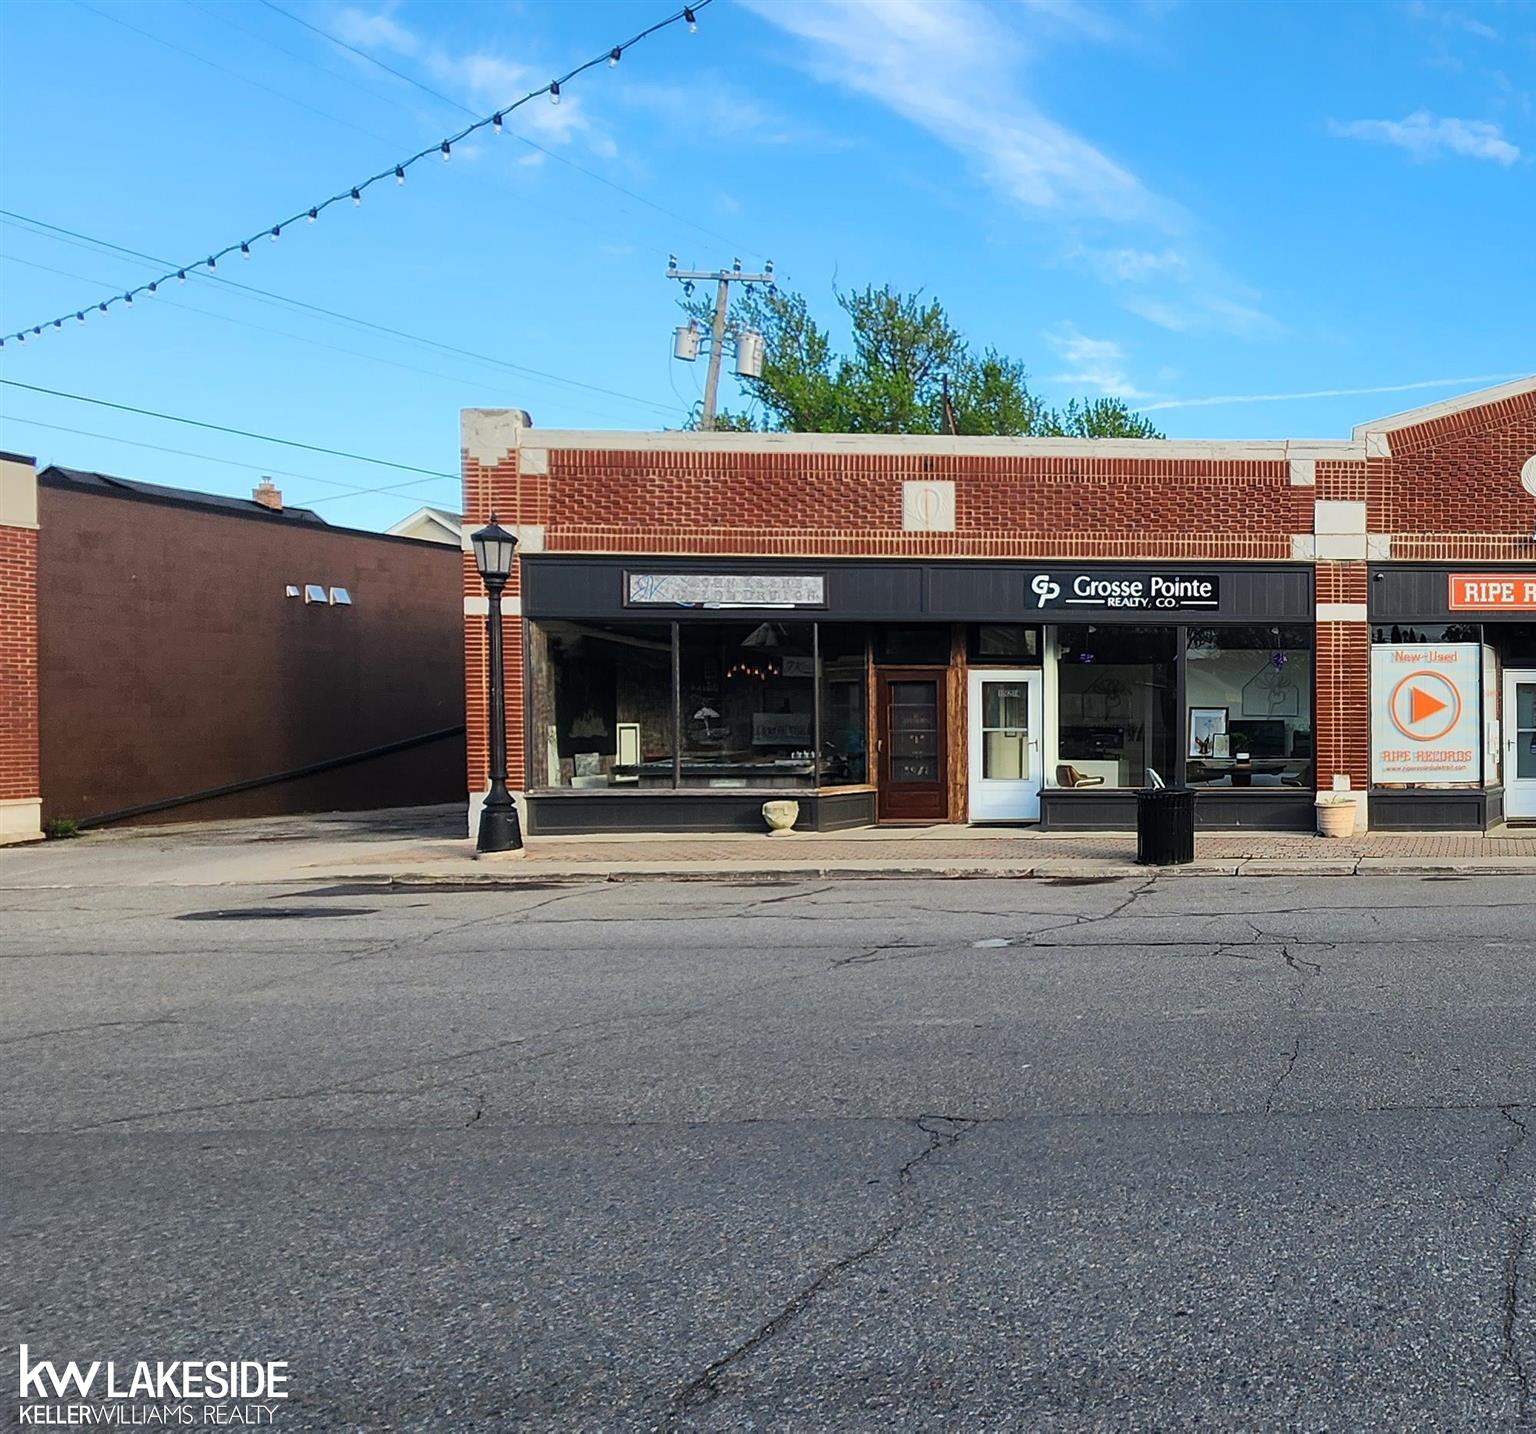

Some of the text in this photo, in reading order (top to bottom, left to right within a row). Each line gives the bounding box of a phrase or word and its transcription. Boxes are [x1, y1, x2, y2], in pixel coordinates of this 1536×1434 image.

[1073, 575, 1212, 597] Grosse Pointe
[1464, 583, 1515, 603] RIPE
[1382, 750, 1473, 762] RIPE RECORDS
